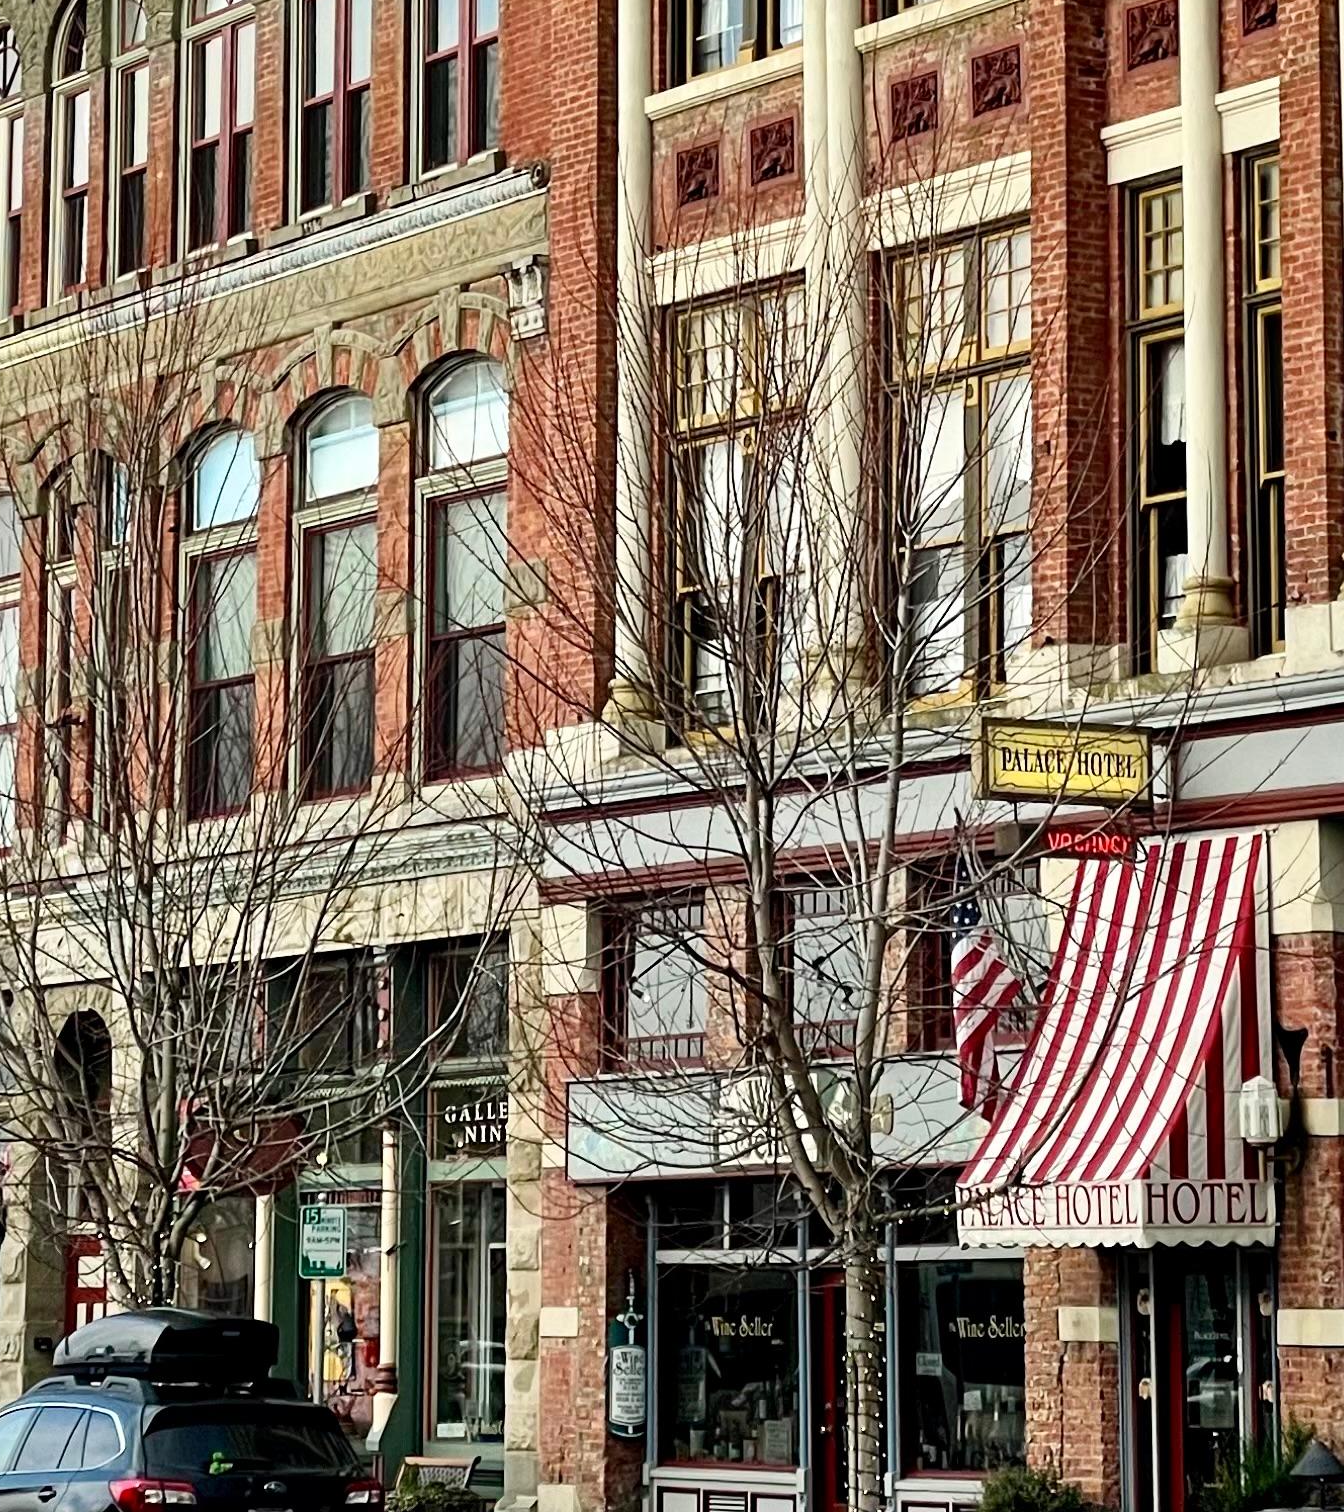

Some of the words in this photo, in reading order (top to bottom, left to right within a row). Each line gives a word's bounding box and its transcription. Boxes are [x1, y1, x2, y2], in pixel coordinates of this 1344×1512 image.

[1001, 746, 1067, 774] PALACE
[1077, 751, 1137, 779] HOTEL
[305, 1208, 320, 1225] 15
[959, 1185, 1045, 1226] PALACE
[1056, 1183, 1138, 1225] HOTEL
[1145, 1182, 1269, 1225] HOTEL
[711, 1316, 736, 1337] Wine
[738, 1314, 774, 1338] Seller
[956, 1317, 985, 1338] Wine
[987, 1314, 1026, 1339] Seller
